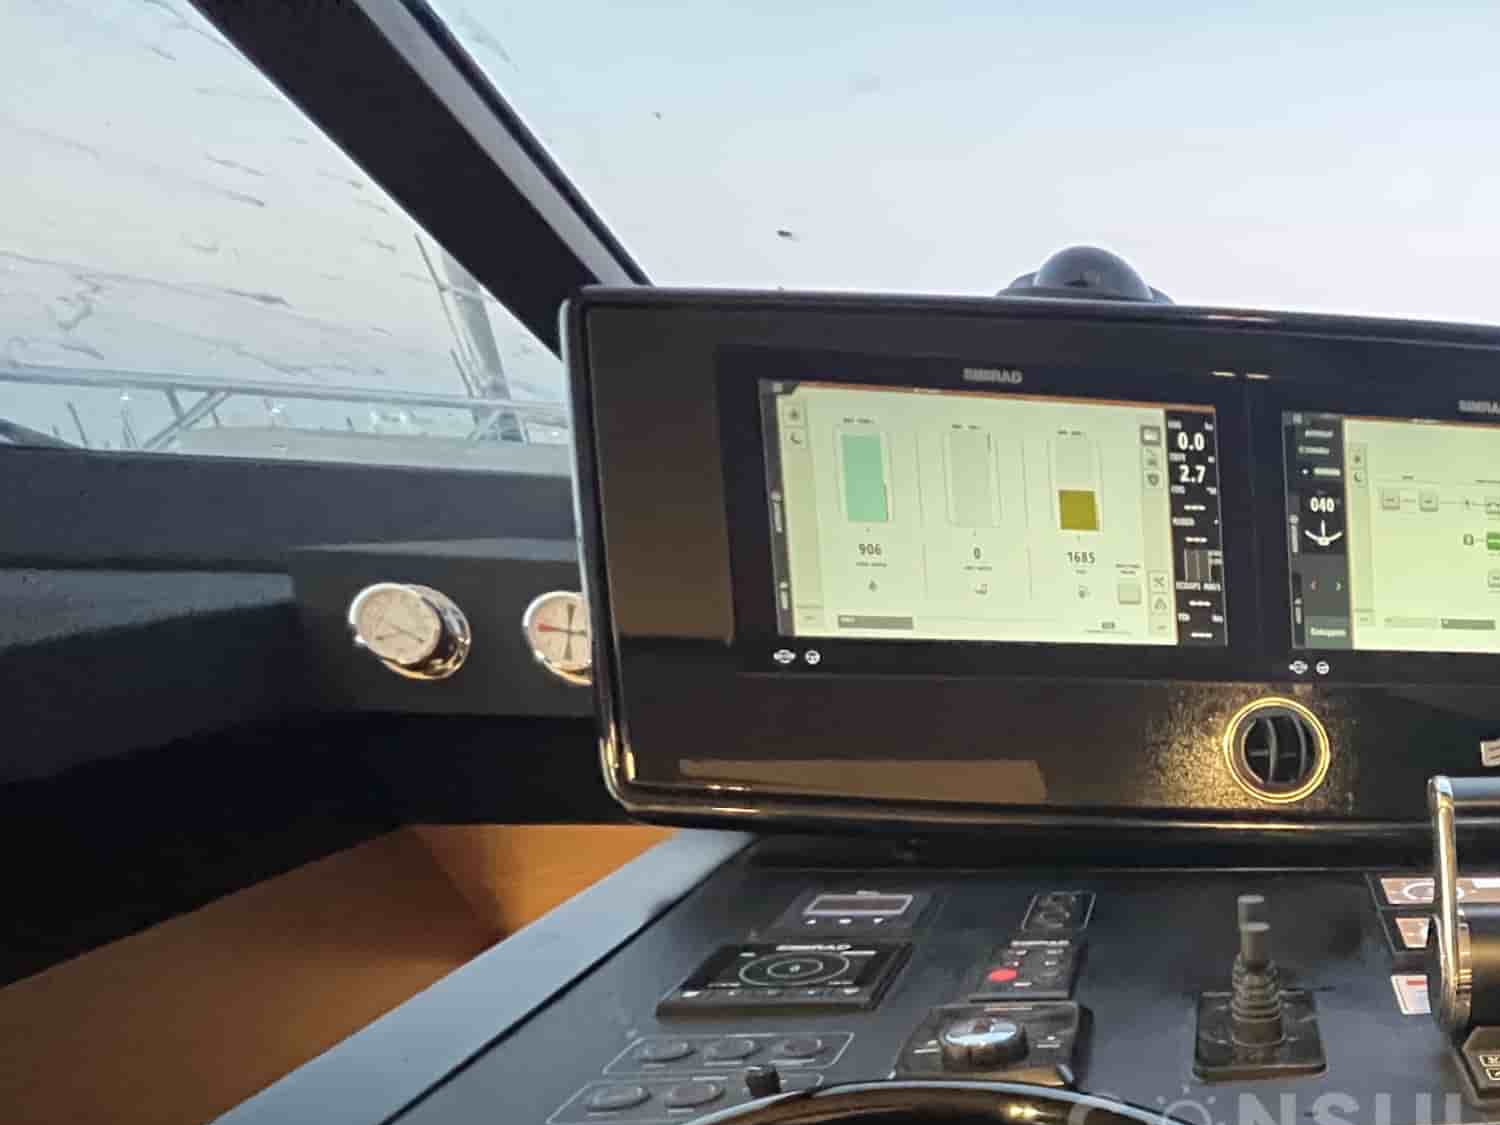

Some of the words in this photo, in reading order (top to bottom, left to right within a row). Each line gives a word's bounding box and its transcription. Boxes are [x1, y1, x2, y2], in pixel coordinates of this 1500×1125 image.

[963, 367, 1023, 384] RAD
[1177, 432, 1205, 450] 0.0
[1178, 465, 1206, 483] 2.7
